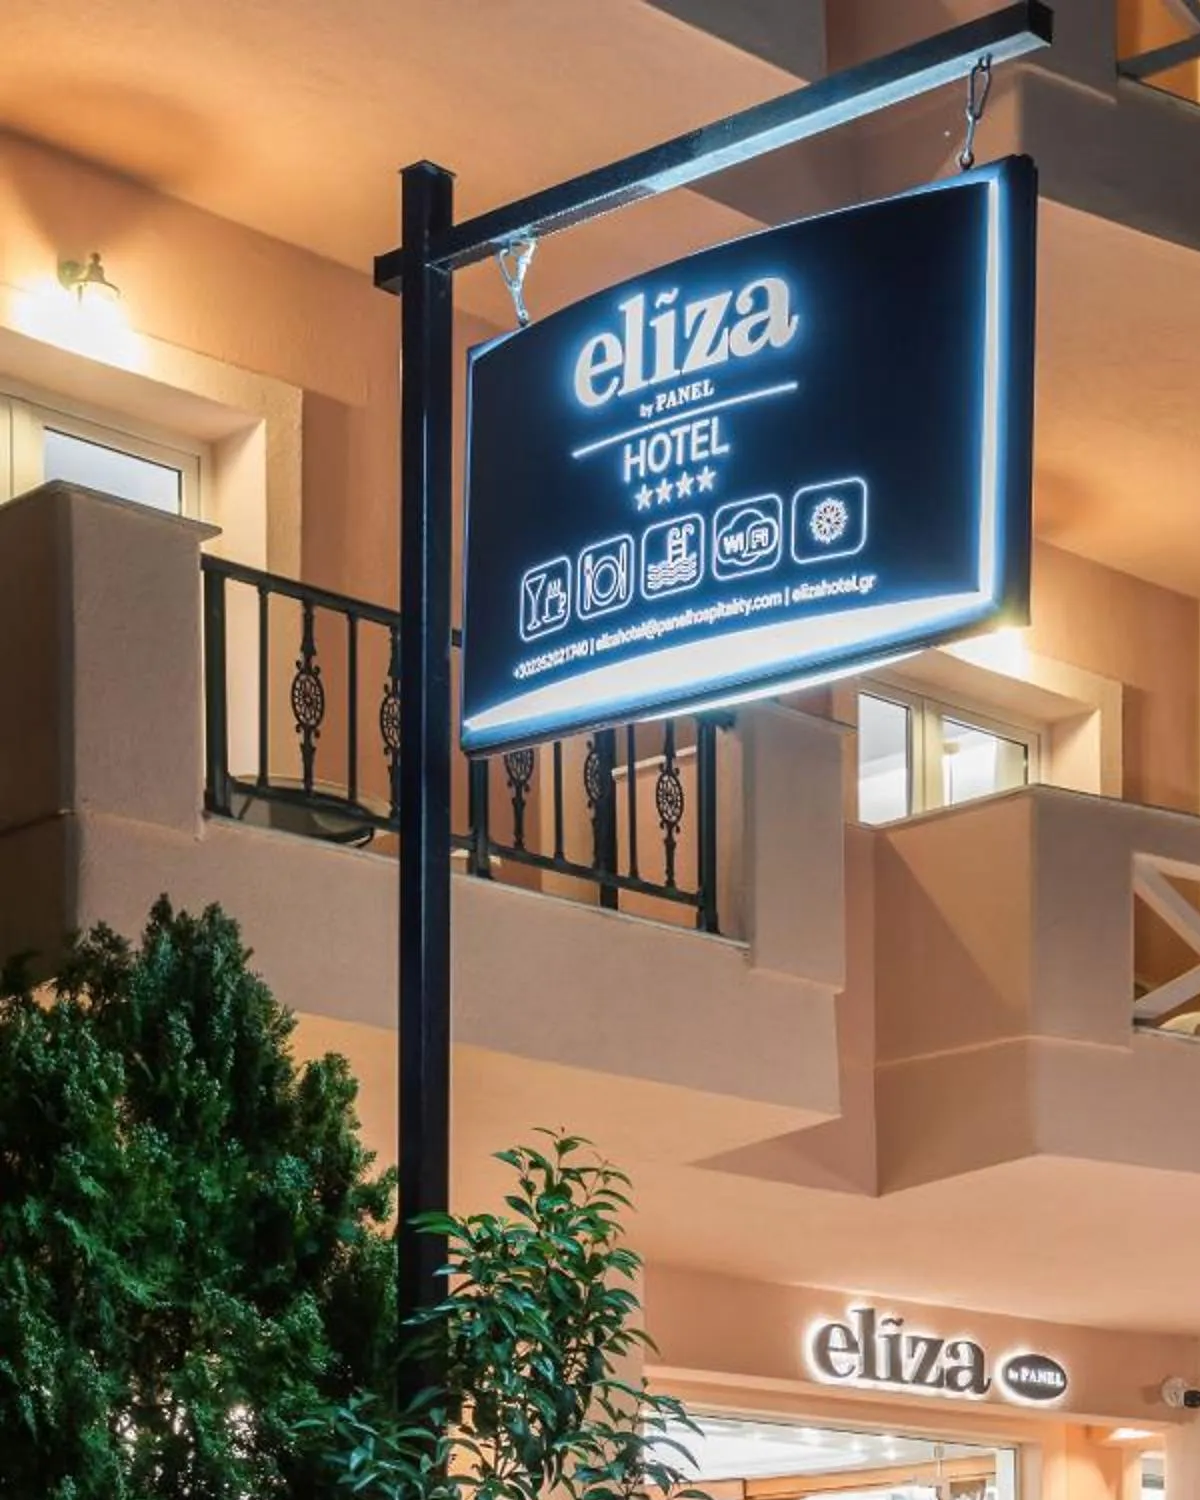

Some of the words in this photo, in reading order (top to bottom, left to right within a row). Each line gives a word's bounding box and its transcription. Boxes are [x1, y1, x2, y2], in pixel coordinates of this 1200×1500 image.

[655, 379, 715, 412] PANEL
[623, 415, 730, 484] HOTEL
[791, 573, 877, 602] elizahotel.gr
[1021, 1366, 1065, 1388] PANEL
